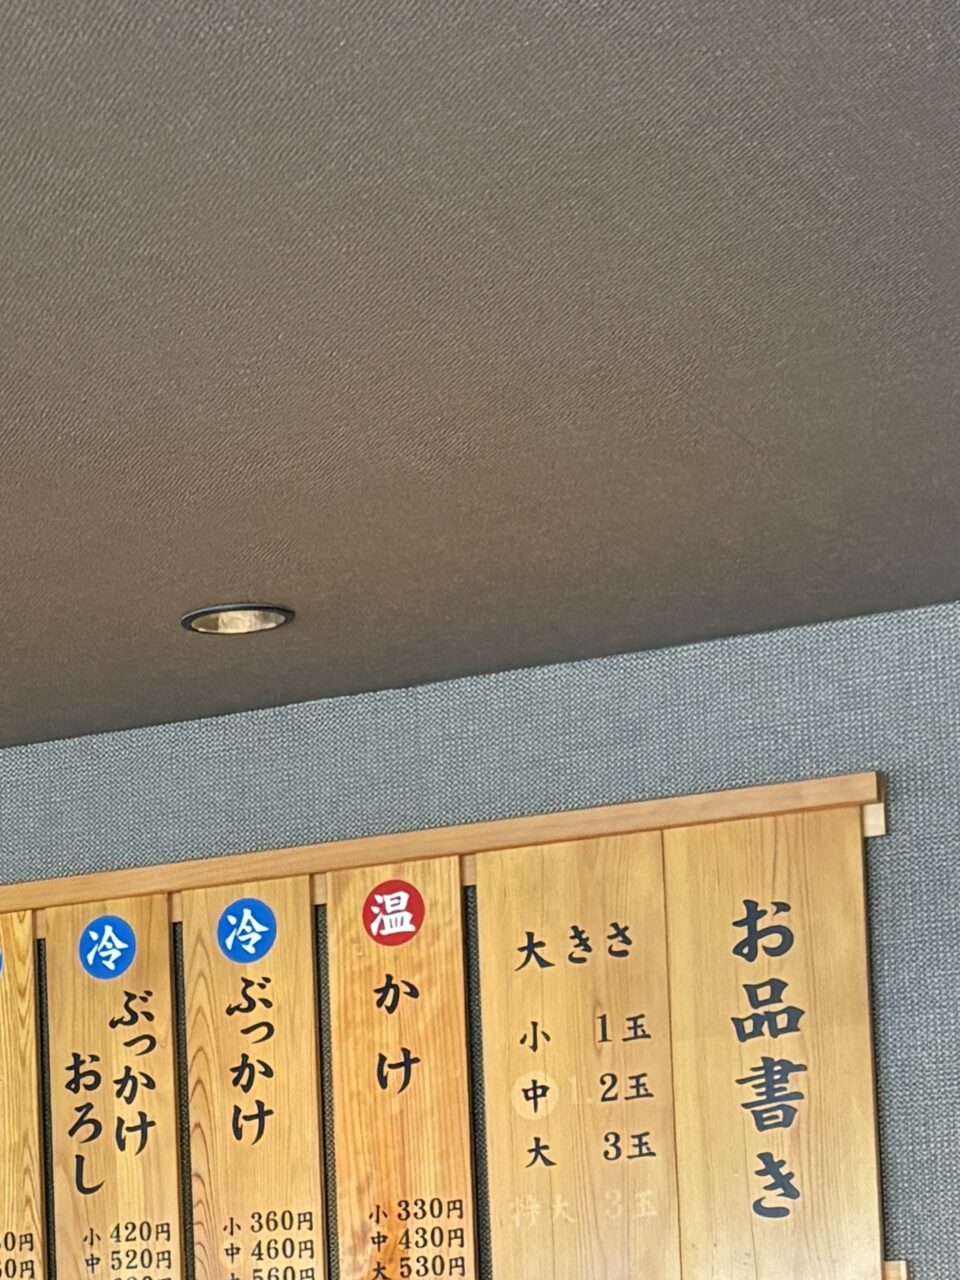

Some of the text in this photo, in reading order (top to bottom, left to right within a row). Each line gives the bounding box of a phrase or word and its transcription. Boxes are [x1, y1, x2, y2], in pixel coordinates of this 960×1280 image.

[225, 908, 270, 954] 冷
[370, 890, 416, 936] 温
[87, 924, 129, 970] 冷
[515, 922, 632, 971] 大きさ
[373, 973, 420, 1094] かけ
[519, 1014, 651, 1052] 小 1玉
[109, 990, 156, 1156] ぶっかけ
[226, 976, 274, 1145] ぶっかけ
[731, 899, 808, 1218] お品書き
[521, 1073, 654, 1114] 中 2玉
[65, 1052, 105, 1195] おろし
[525, 1131, 656, 1168] 大 3玉
[223, 1210, 313, 1236] 小 360円
[369, 1198, 463, 1225] 小 330円
[82, 1221, 171, 1247] 小 420円
[224, 1238, 314, 1264] 中 460円
[370, 1226, 465, 1252] 中 430円
[84, 1248, 172, 1274] 中 520円
[400, 1255, 465, 1278] 530円
